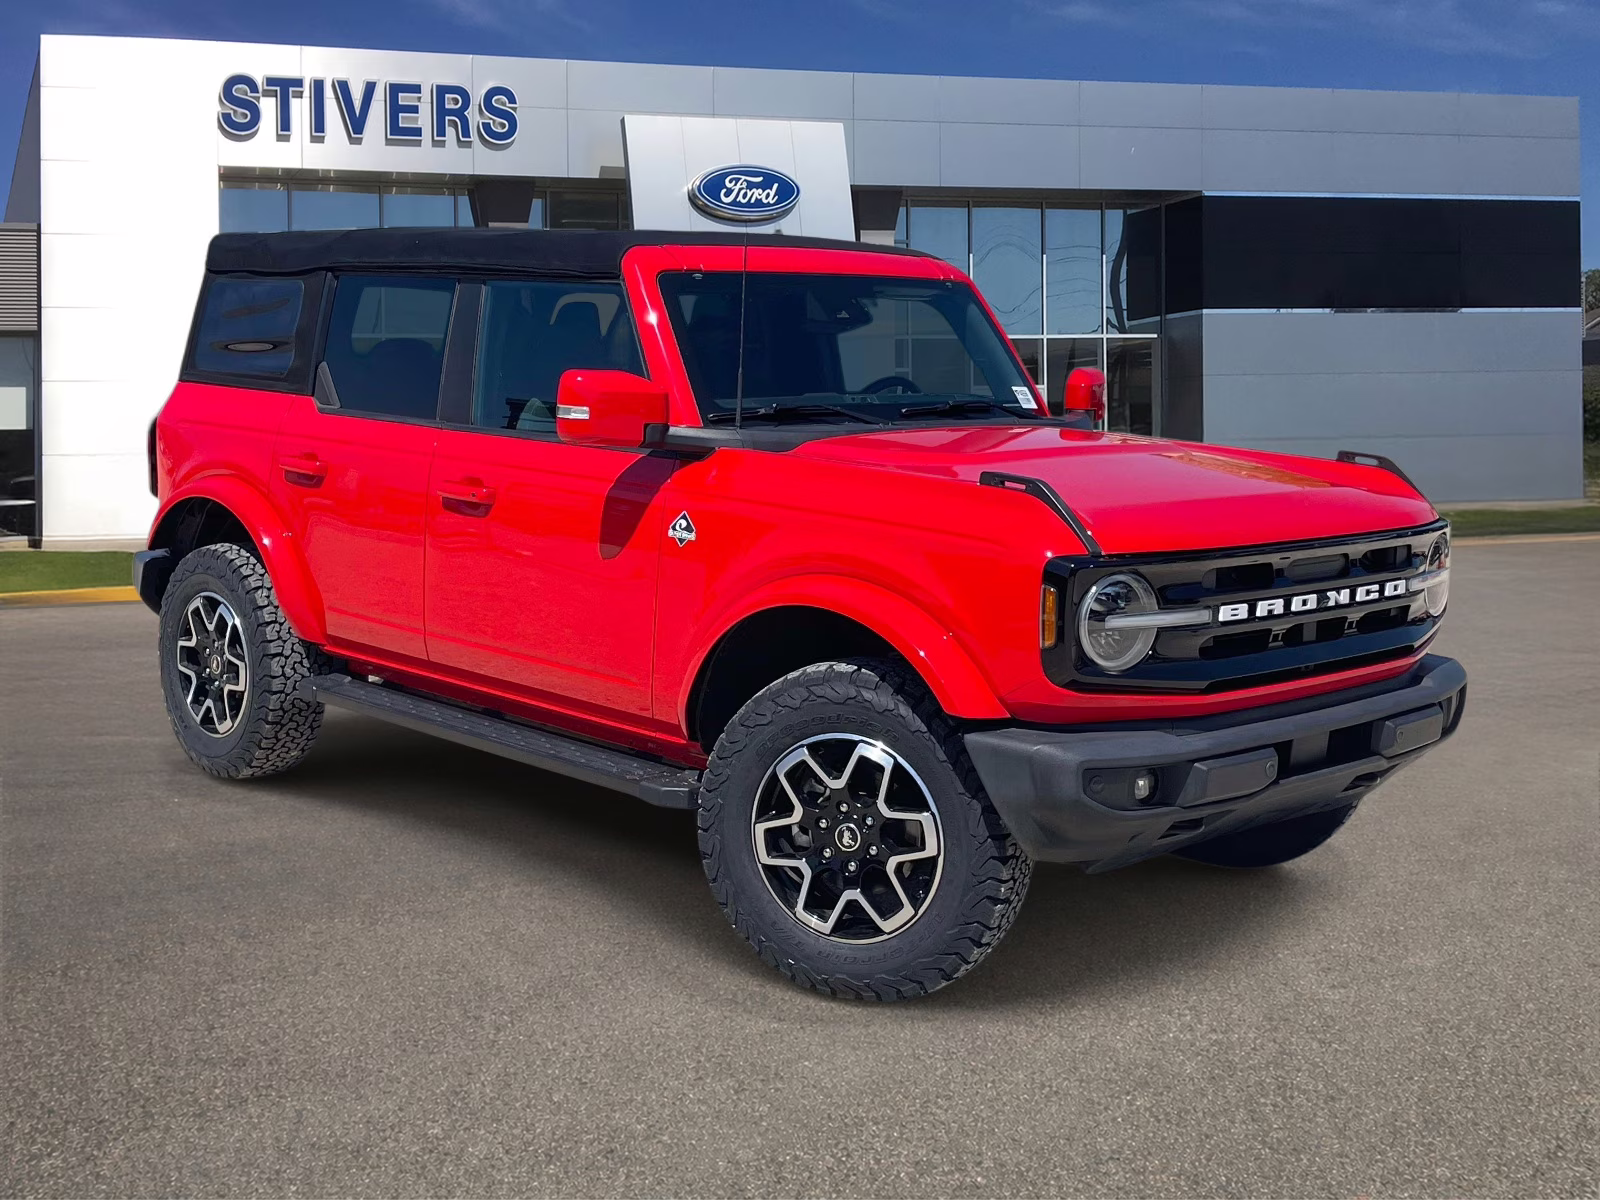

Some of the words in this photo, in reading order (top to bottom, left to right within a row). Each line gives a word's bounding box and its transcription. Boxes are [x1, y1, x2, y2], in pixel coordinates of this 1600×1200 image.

[218, 73, 518, 147] STIVERS
[720, 174, 779, 204] Ford
[1218, 579, 1406, 622] BRONCO
